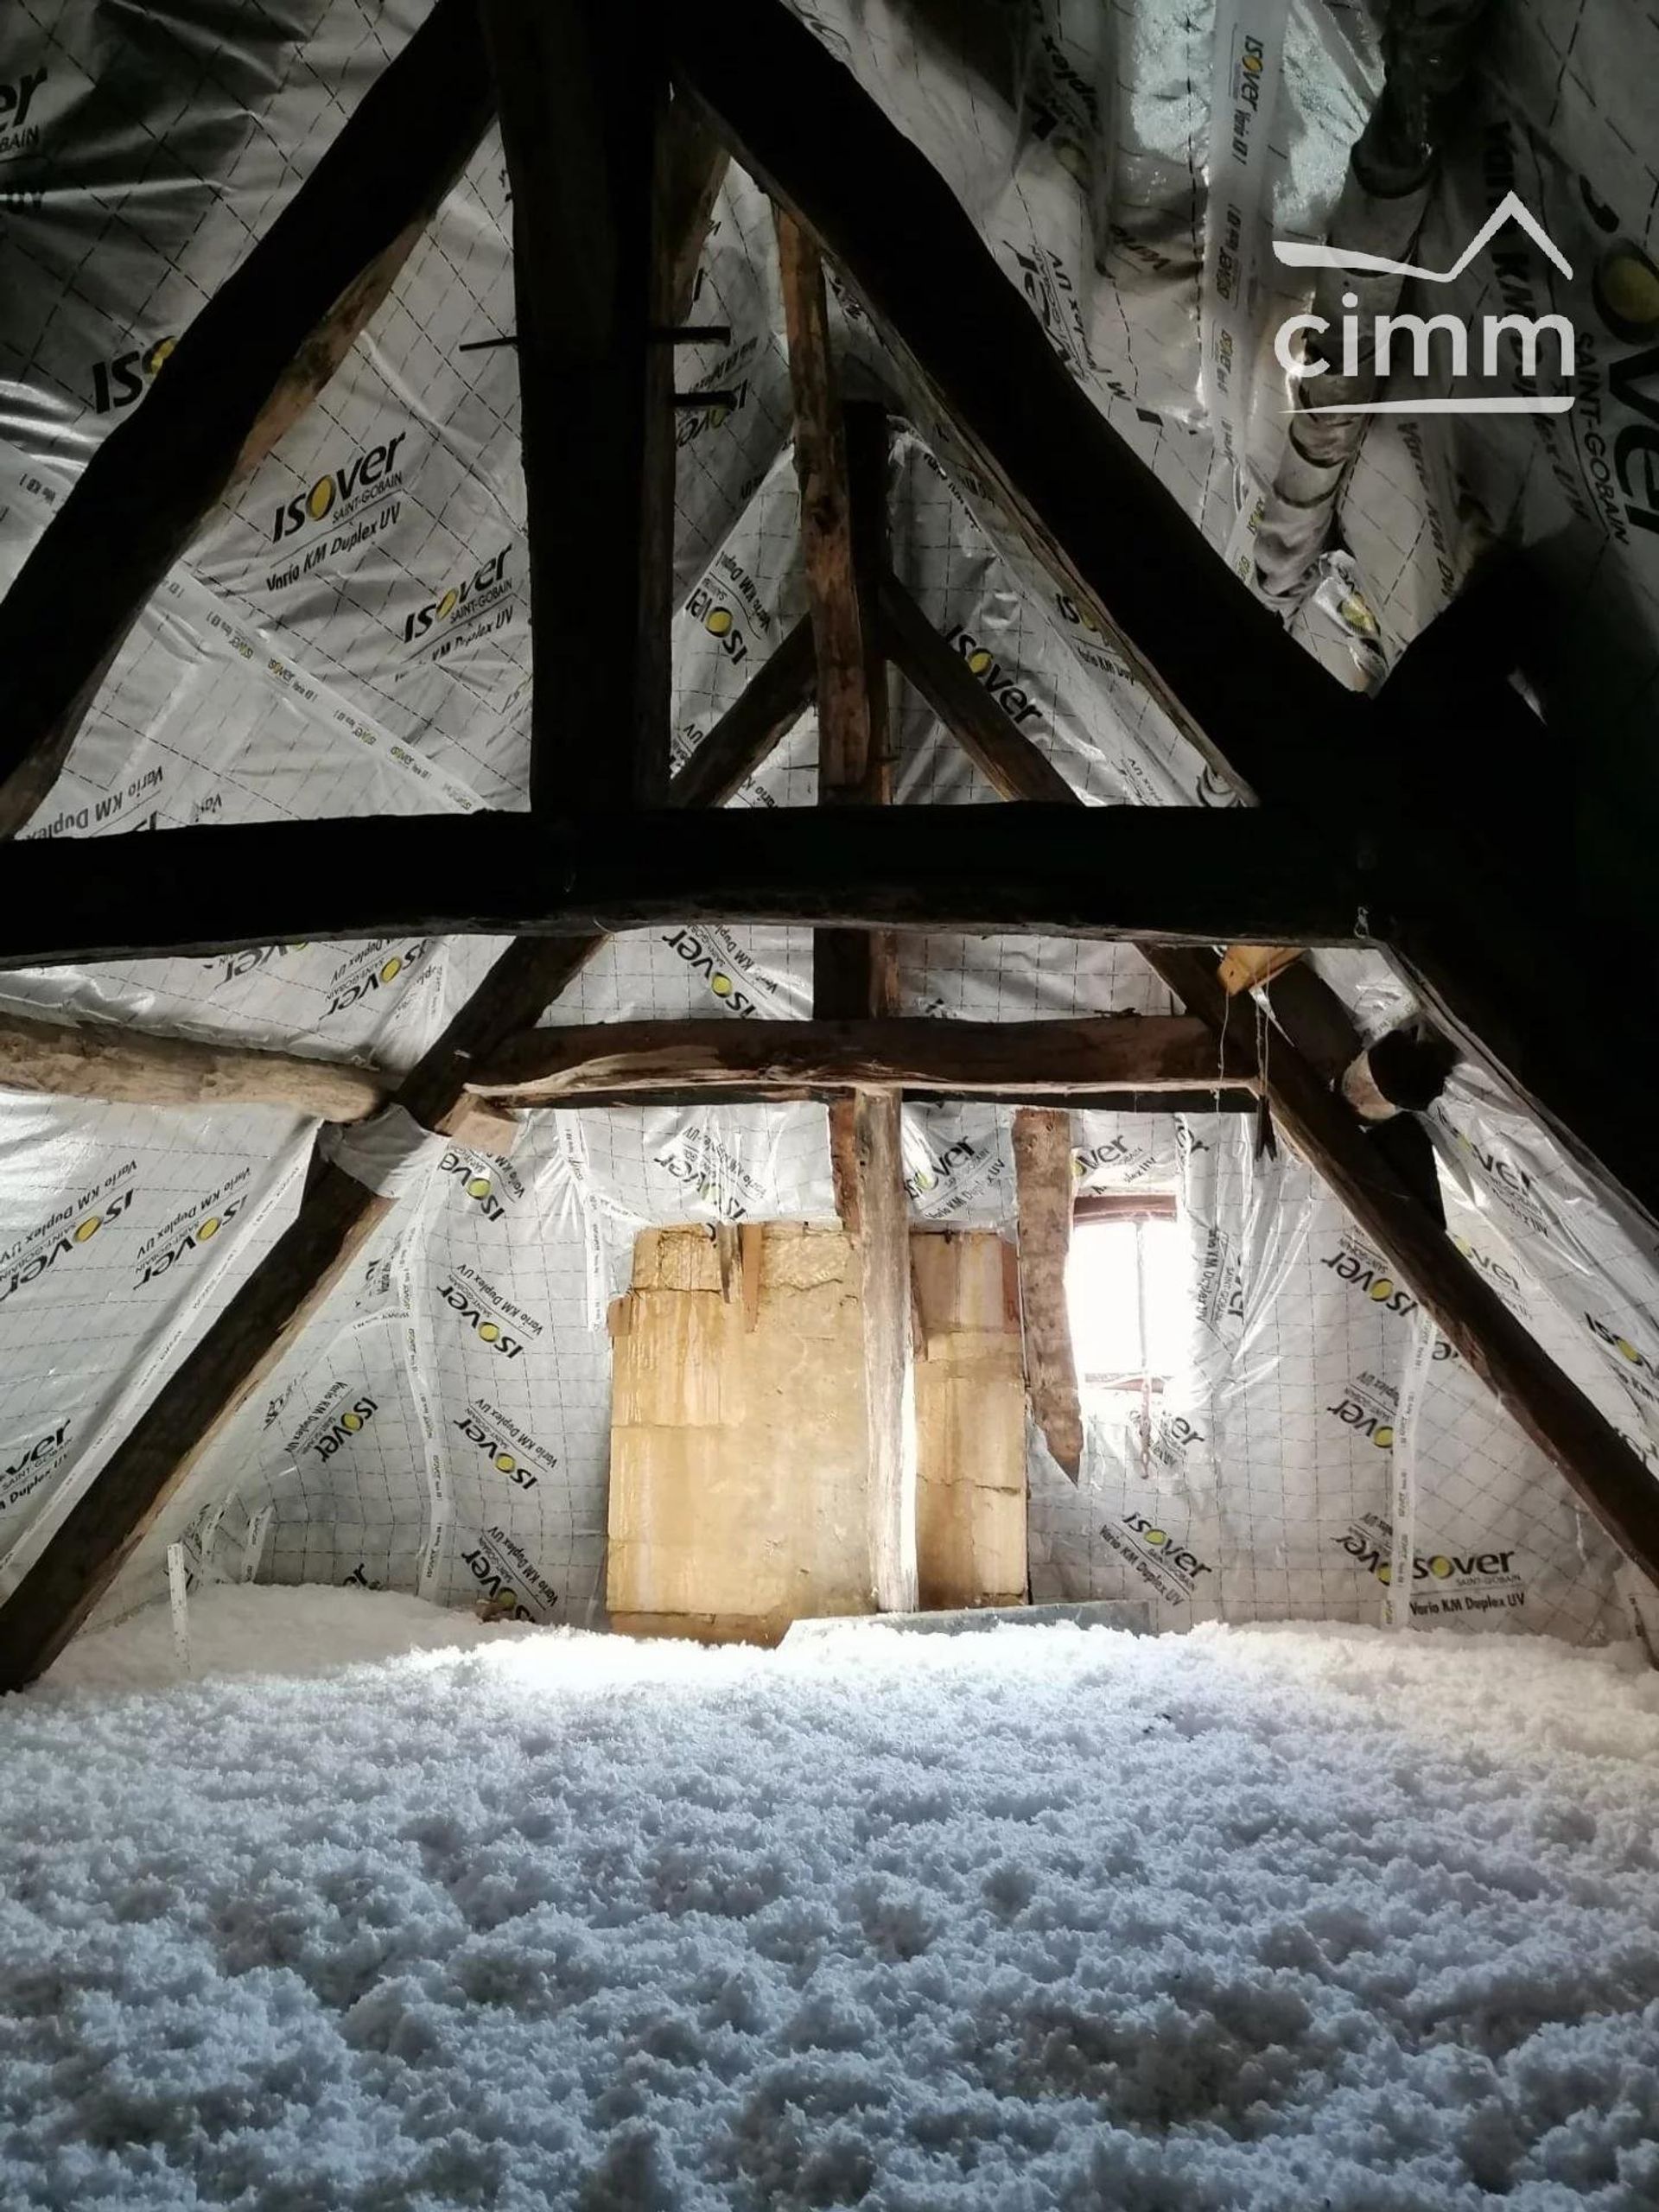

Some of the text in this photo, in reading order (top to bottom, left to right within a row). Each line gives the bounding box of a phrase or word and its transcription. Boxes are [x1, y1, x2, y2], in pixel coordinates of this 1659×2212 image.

[1576, 332, 1630, 545] SAINT-GOBAIN
[303, 543, 327, 574] KM
[330, 522, 377, 556] Duplex
[379, 501, 401, 530] UV
[95, 791, 123, 822] KM
[128, 766, 163, 798] Vario
[734, 950, 756, 971] KM
[78, 1185, 99, 1211] KM
[105, 1160, 137, 1187] Vario
[24, 1205, 73, 1244] Duplex
[157, 1205, 197, 1239] Duplex
[200, 1189, 220, 1211] KM
[137, 1237, 155, 1260] UV
[456, 1263, 544, 1336] Vario KM Duplex UV
[1320, 1252, 1419, 1317] ISOver
[436, 1285, 524, 1359] ISOver
[314, 1396, 378, 1463] ISOver
[453, 1419, 537, 1490] ISOver
[474, 1398, 558, 1468] Vario KM Duplex UV
[487, 1526, 558, 1608] Vario KM Duplex UV
[1099, 1524, 1185, 1606] Vario KM Duplex UV
[1409, 1592, 1525, 1616] Vario KM Duplex UV
